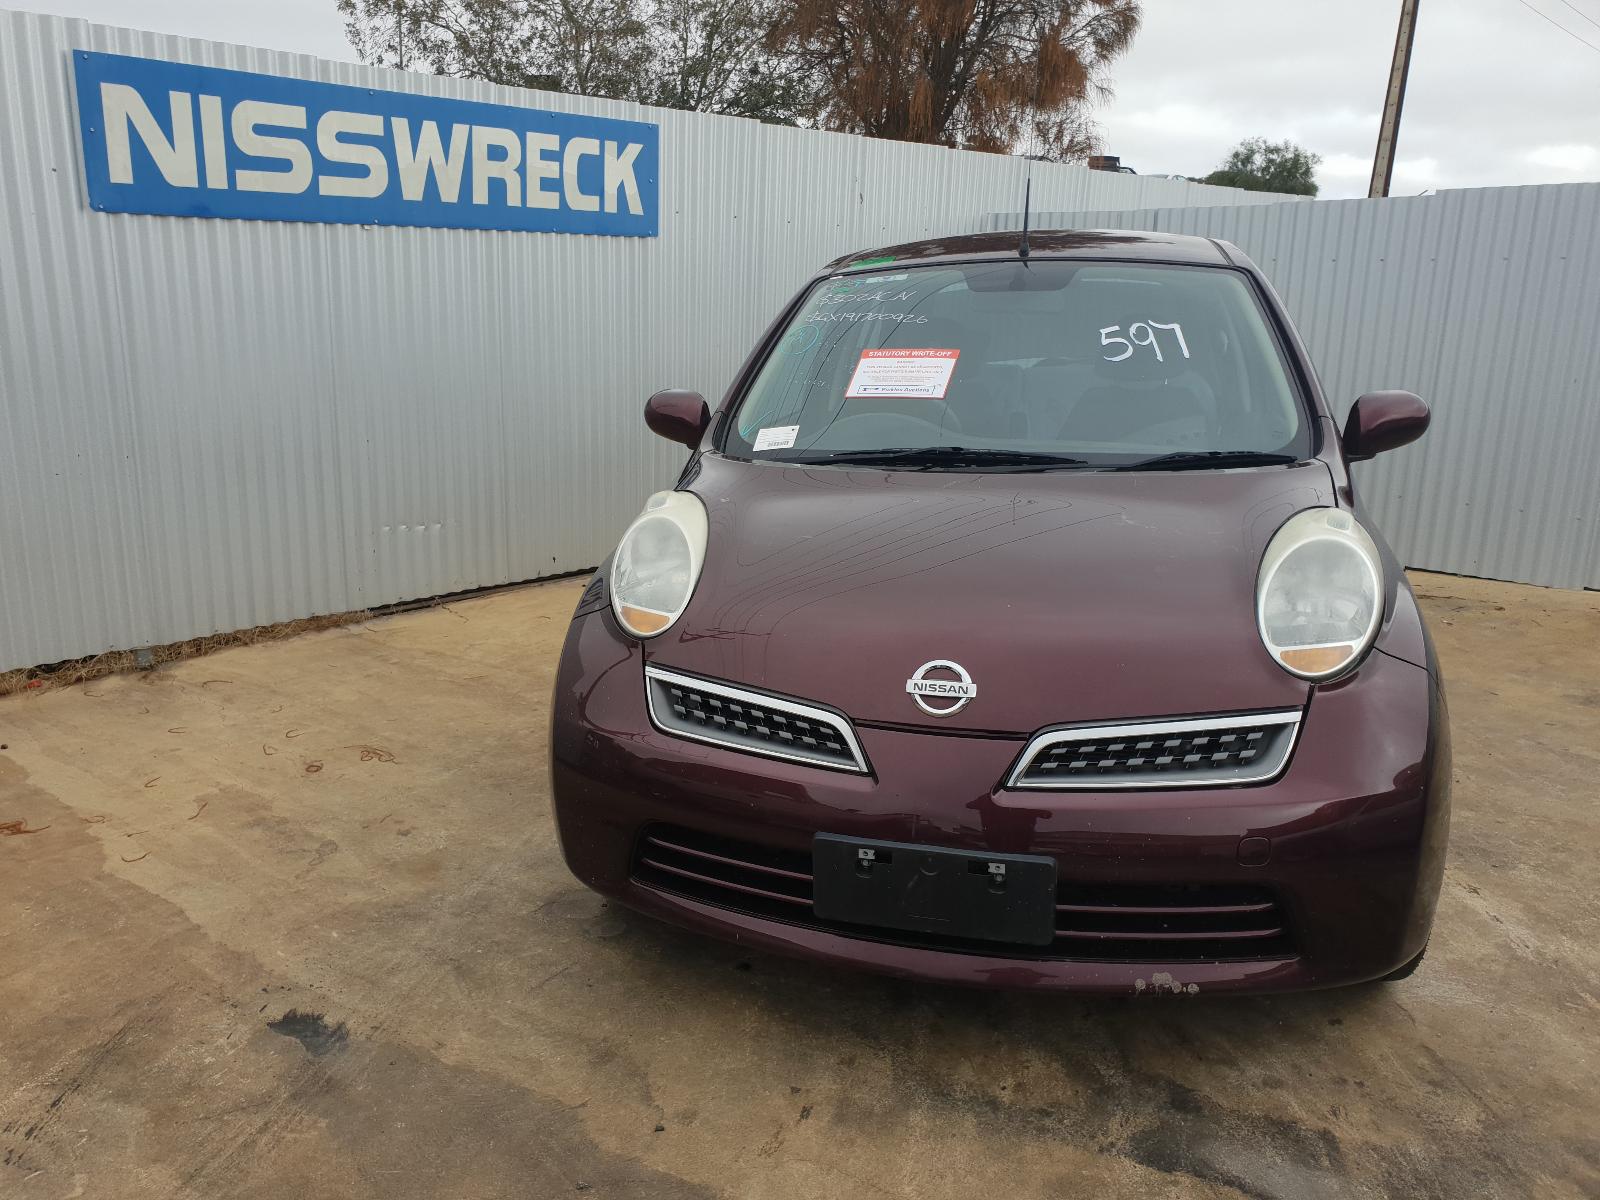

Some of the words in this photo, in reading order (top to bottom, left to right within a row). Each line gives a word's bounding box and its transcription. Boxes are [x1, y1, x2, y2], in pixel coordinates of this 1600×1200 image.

[100, 82, 644, 216] NISSWRECK
[1099, 319, 1190, 362] 597
[913, 682, 969, 695] NISSAN
